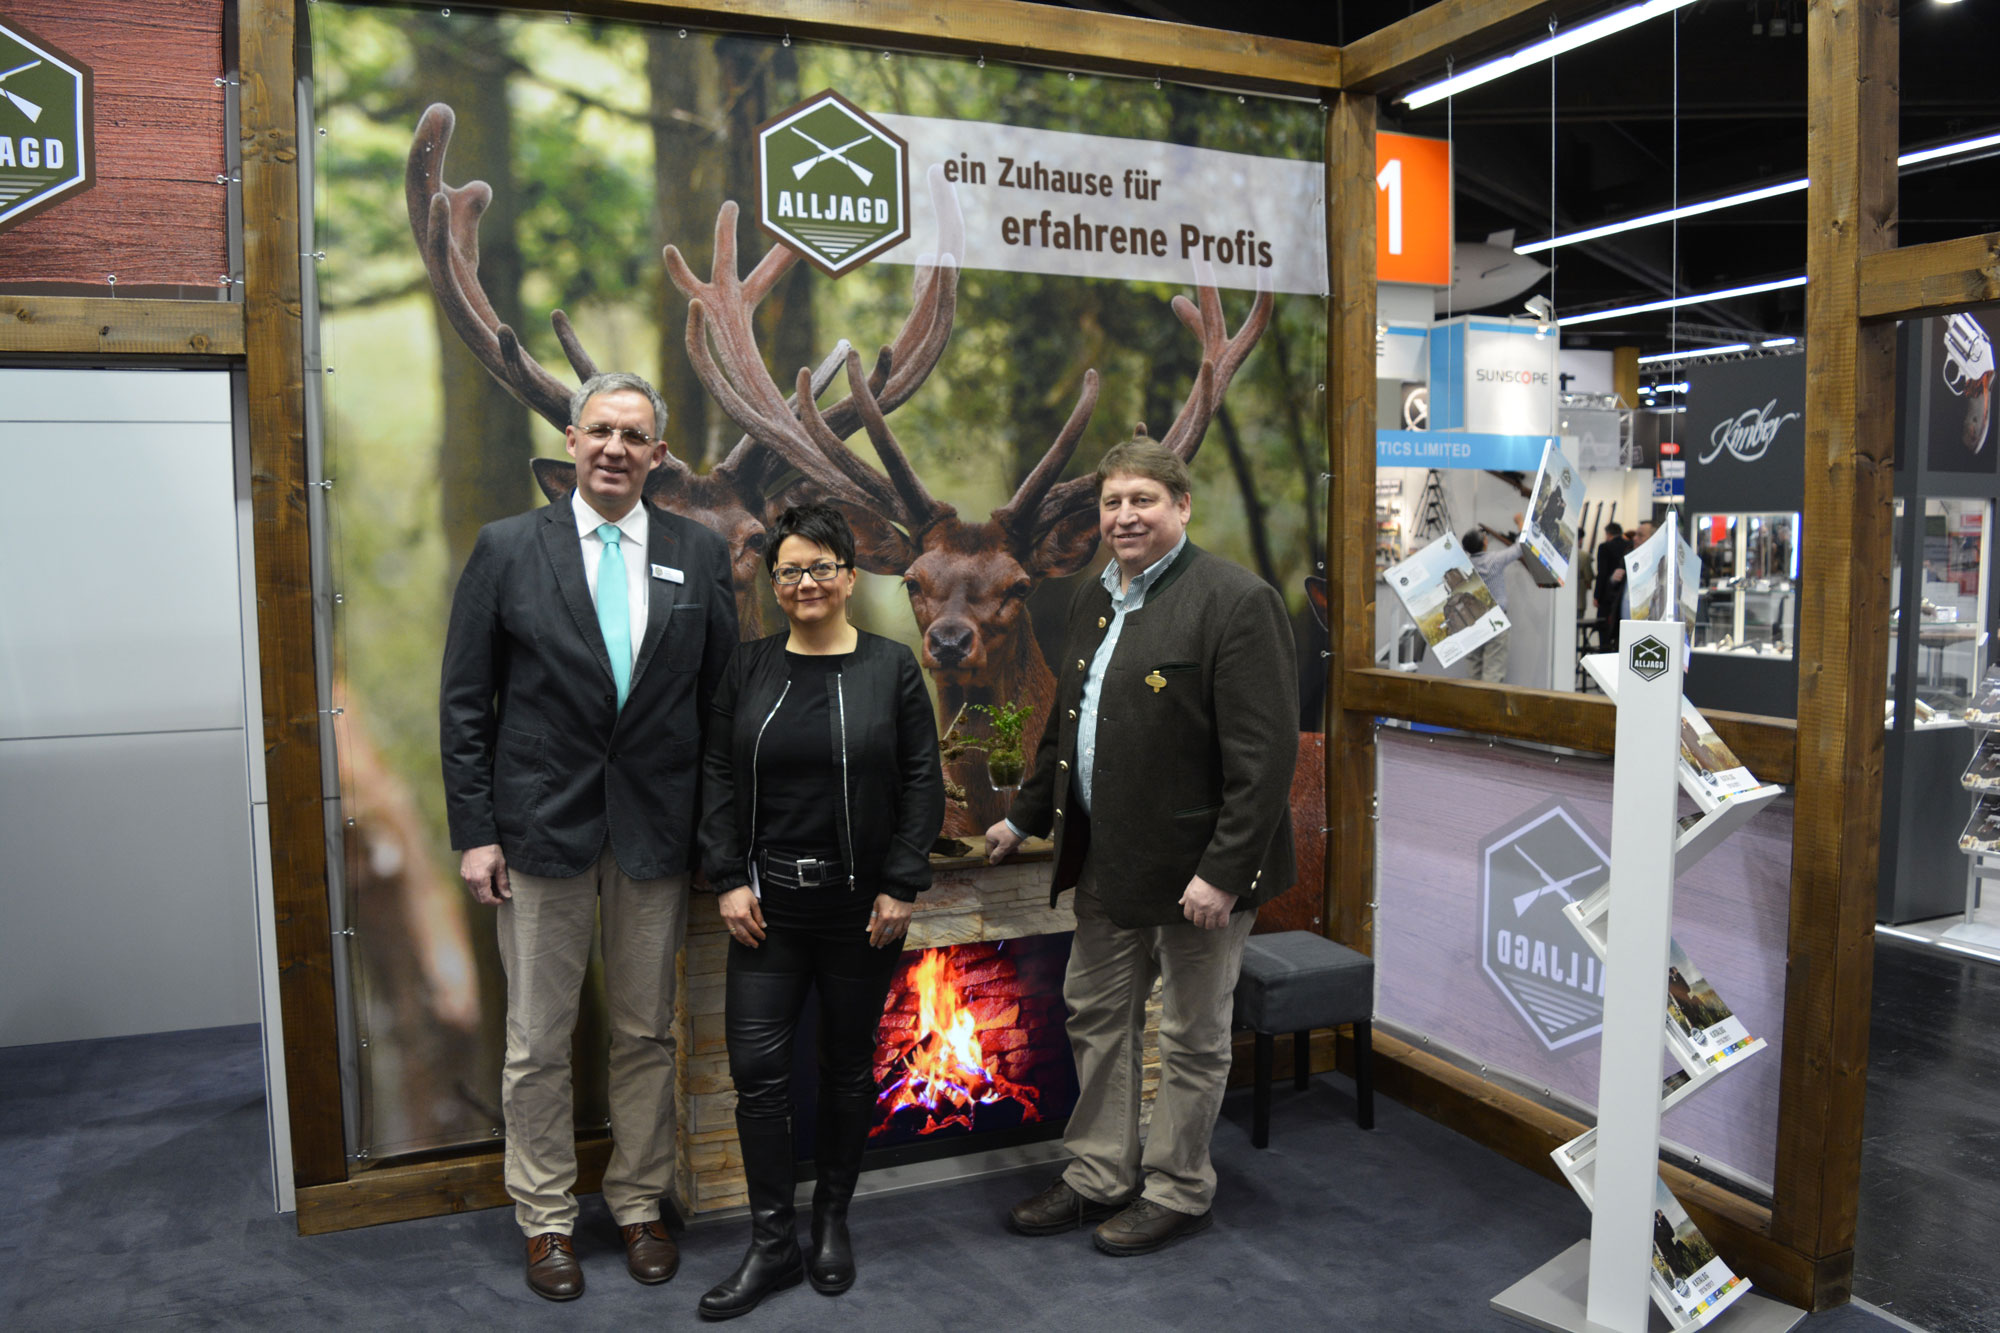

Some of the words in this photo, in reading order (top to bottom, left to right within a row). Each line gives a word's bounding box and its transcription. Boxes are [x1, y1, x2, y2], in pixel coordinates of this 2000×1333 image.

[943, 152, 986, 185] ein
[998, 157, 1113, 197] Zuhause
[1123, 169, 1162, 201] für
[778, 190, 889, 224] ALLJAGD
[1376, 158, 1403, 256] 1
[1001, 210, 1168, 257] erfahrene
[1180, 223, 1273, 268] Profis
[1476, 369, 1549, 385] SUNSCOPE
[1376, 441, 1412, 457] TICS
[1414, 442, 1472, 458] LIMITED
[1698, 398, 1796, 465] Kimber
[1634, 659, 1664, 669] ALLJAGD
